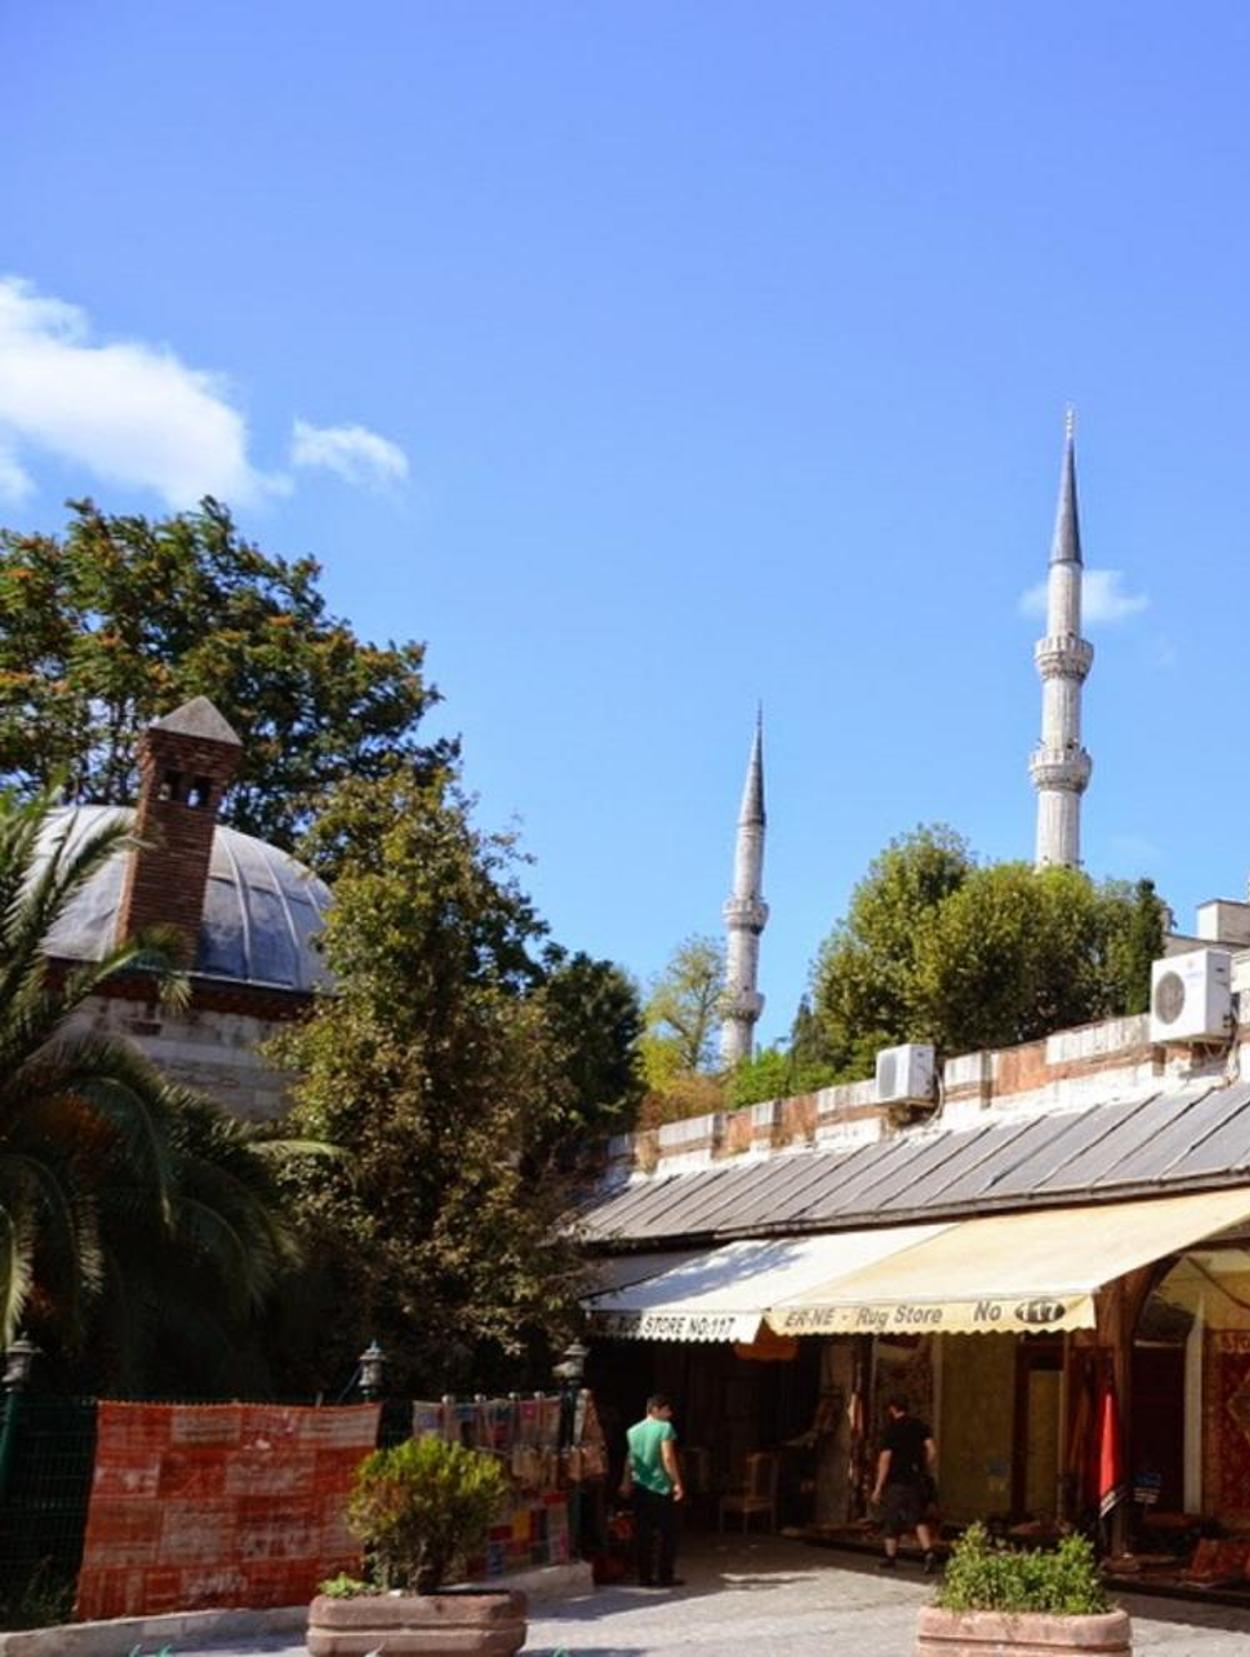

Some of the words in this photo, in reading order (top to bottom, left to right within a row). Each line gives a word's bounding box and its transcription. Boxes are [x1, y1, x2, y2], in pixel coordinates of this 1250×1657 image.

[643, 1316, 686, 1334] STORE
[689, 1317, 736, 1335] NO:117
[856, 1306, 889, 1330] Rug
[894, 1304, 944, 1324] Store
[973, 1301, 1002, 1322] No
